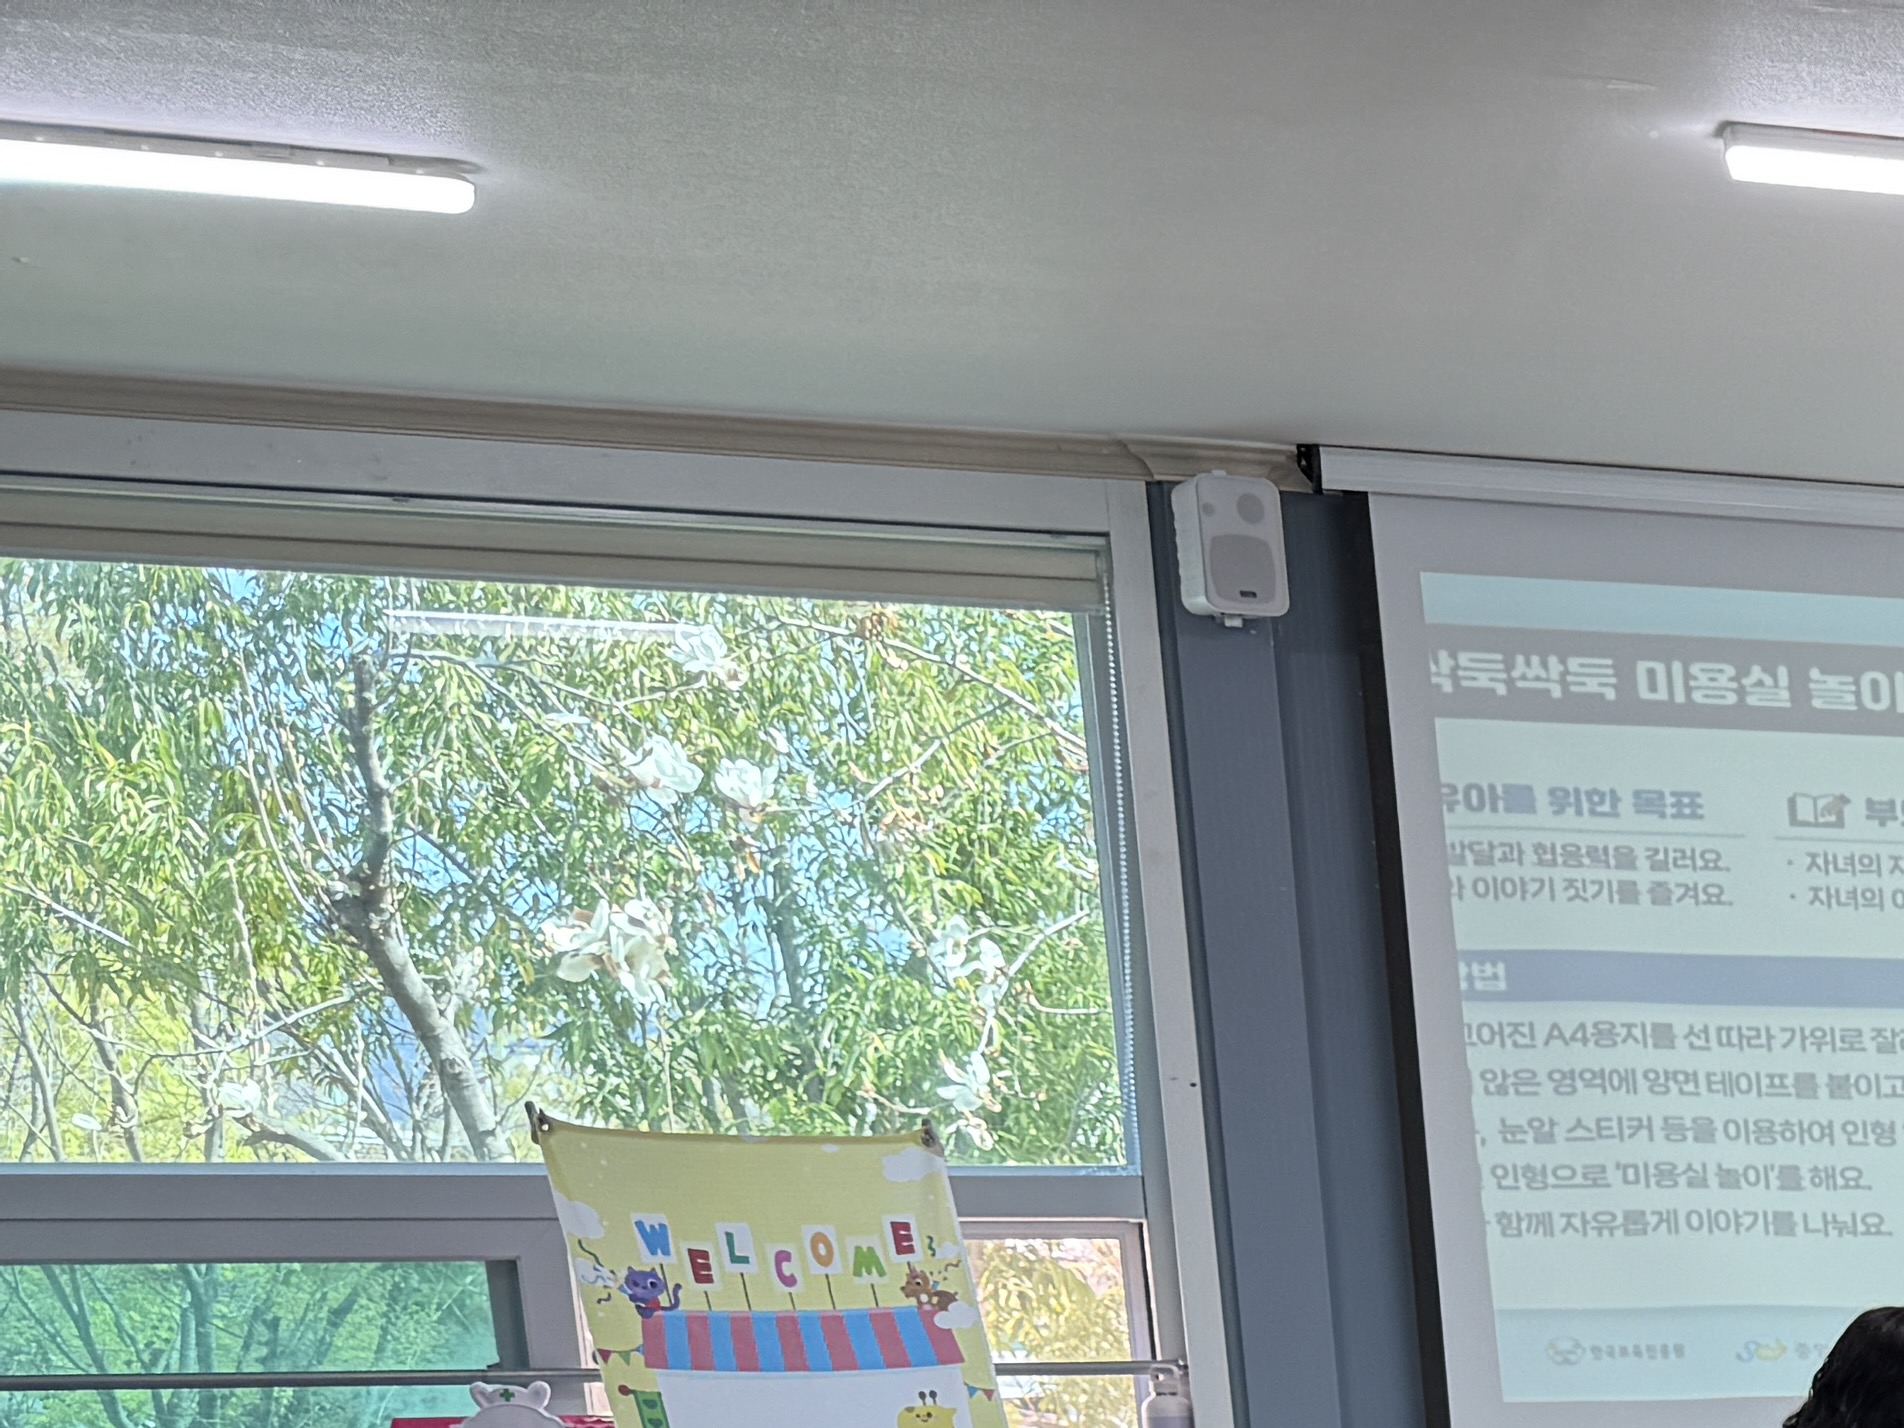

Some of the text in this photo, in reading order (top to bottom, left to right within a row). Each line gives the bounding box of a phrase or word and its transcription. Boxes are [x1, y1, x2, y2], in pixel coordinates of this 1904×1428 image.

[1636, 660, 1792, 707] 미용실
[1547, 787, 1622, 820] 위한
[1632, 788, 1704, 820] 목표
[1805, 851, 1882, 878] 자녀의
[1472, 877, 1556, 904] 이야기
[1646, 882, 1734, 907] 즐겨요.
[1808, 886, 1884, 912] 자녀의
[1543, 1021, 1678, 1051] A4용지를
[1683, 1023, 1713, 1052] 선
[1716, 1024, 1776, 1053] 따라
[1780, 1025, 1868, 1055] 가위로
[1479, 1066, 1543, 1097] 않은
[1546, 1066, 1638, 1097] 영역에
[1643, 1067, 1701, 1097] 양면
[1705, 1070, 1820, 1101] 테이프를
[1498, 1115, 1558, 1145] 눈알
[1564, 1115, 1655, 1144] 스티커
[1660, 1115, 1718, 1145] 등을
[1722, 1117, 1836, 1148] 이용하여
[1841, 1119, 1898, 1148] 인형
[1490, 1161, 1612, 1190] 인형으로
[1809, 1164, 1874, 1192] 해요.
[1498, 1208, 1894, 1239] 함께 자유롭게 이야기를 나눠요.
[634, 1220, 915, 1288] WELCOME
